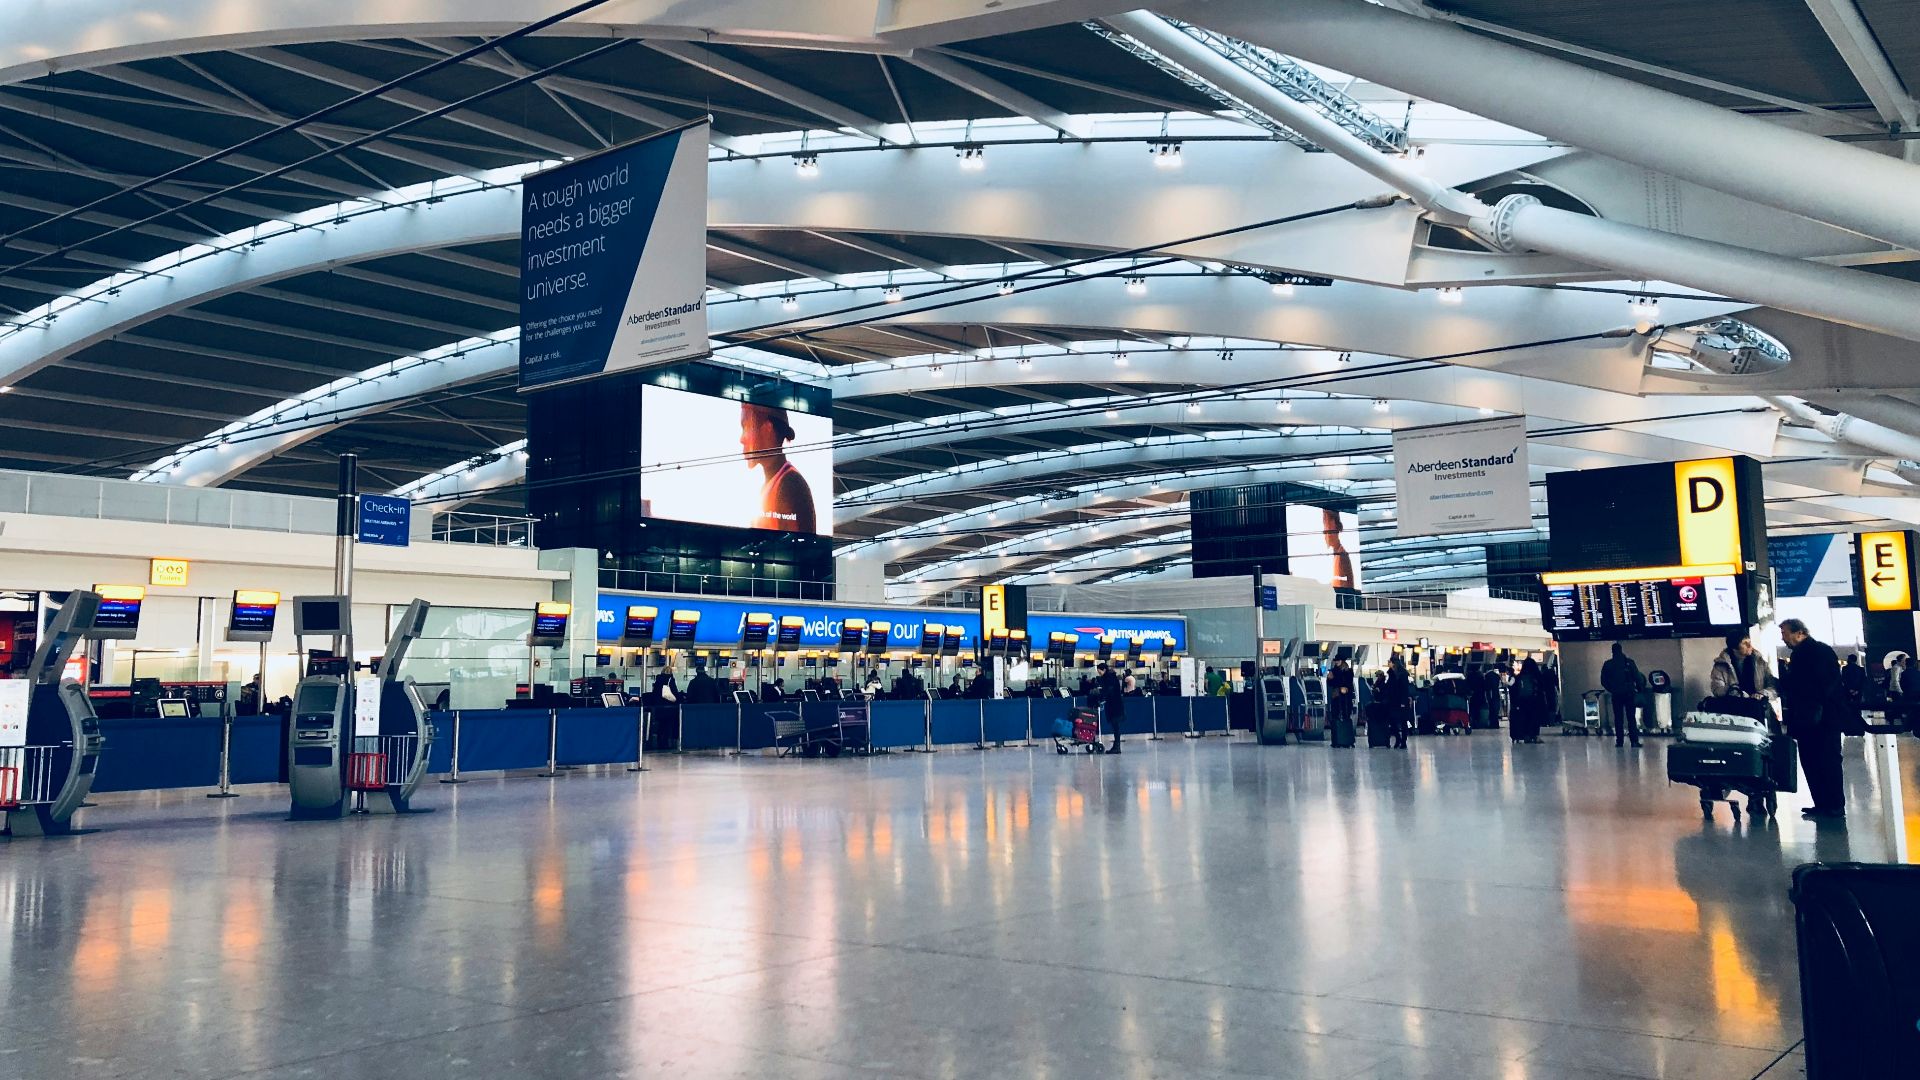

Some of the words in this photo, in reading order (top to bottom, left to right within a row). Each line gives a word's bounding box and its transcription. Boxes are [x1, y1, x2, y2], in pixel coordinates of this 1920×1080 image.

[528, 193, 538, 212] A
[542, 179, 582, 206] tough
[588, 162, 628, 194] world
[528, 212, 570, 241] needs
[575, 212, 584, 228] a
[589, 196, 634, 226] bigger
[528, 234, 606, 271] investment
[528, 272, 588, 300] universe.
[548, 316, 558, 326] the
[558, 313, 576, 323] choice
[576, 311, 587, 321] you
[588, 305, 602, 316] need
[644, 318, 680, 331] Investments
[526, 334, 534, 342] for
[534, 331, 544, 340] the
[544, 326, 572, 338] challenges
[572, 324, 583, 333] you
[525, 354, 542, 364] Capital
[1434, 469, 1486, 480] Investments
[1688, 476, 1724, 514] D
[364, 500, 406, 514] Check-in
[1875, 543, 1894, 568] E
[990, 593, 998, 610] E
[894, 622, 920, 640] our
[1108, 628, 1138, 640] BRITISH
